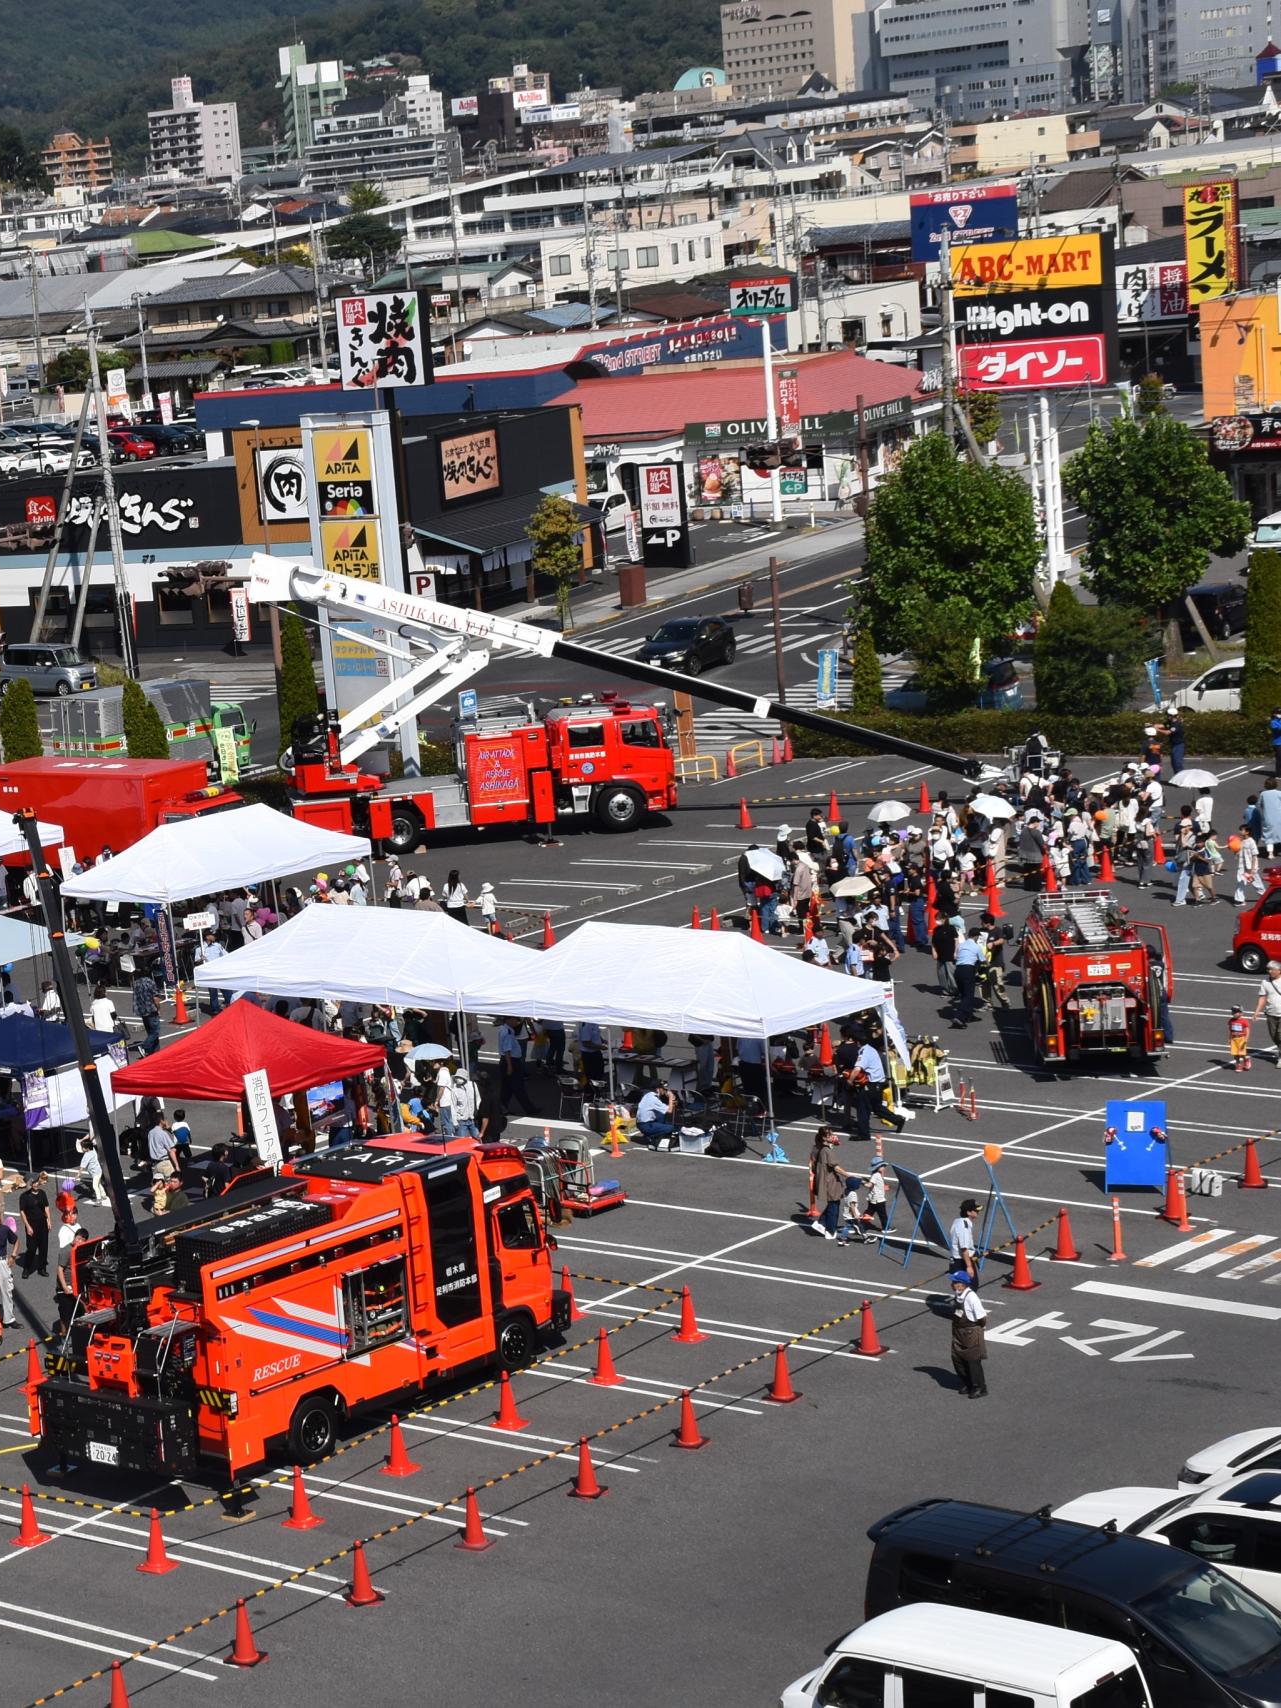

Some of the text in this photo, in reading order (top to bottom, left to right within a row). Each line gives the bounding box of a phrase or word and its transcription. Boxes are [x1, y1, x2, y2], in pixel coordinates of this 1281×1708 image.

[1186, 206, 1228, 296] ラーメン
[959, 250, 1092, 283] ABC-MART
[736, 286, 785, 309] オリーブの丘
[1123, 266, 1148, 317] 肉そば
[1162, 268, 1185, 313] 醤油
[966, 301, 1089, 335] Right-on
[367, 295, 417, 384] 焼肉
[349, 327, 369, 388] きんぐ
[604, 344, 661, 372] 2nd STREET
[977, 350, 1083, 382] ダイソー
[863, 401, 904, 422] OLIVE HILL
[443, 456, 496, 485] 焼肉きんぐ
[273, 468, 302, 502] 肉
[327, 483, 363, 499] Seria
[794, 484, 803, 493] P
[28, 500, 53, 514] 食べ
[66, 492, 194, 534] 焼きんぐ
[666, 530, 681, 547] P
[326, 562, 379, 579] レストラン街
[416, 576, 431, 596] P
[480, 778, 519, 790] ASHIKAGA
[485, 769, 511, 778] RESCUE
[445, 1262, 466, 1277] 栃木県
[436, 1274, 479, 1297] 足利市消防本部
[253, 1353, 302, 1383] RESCUE
